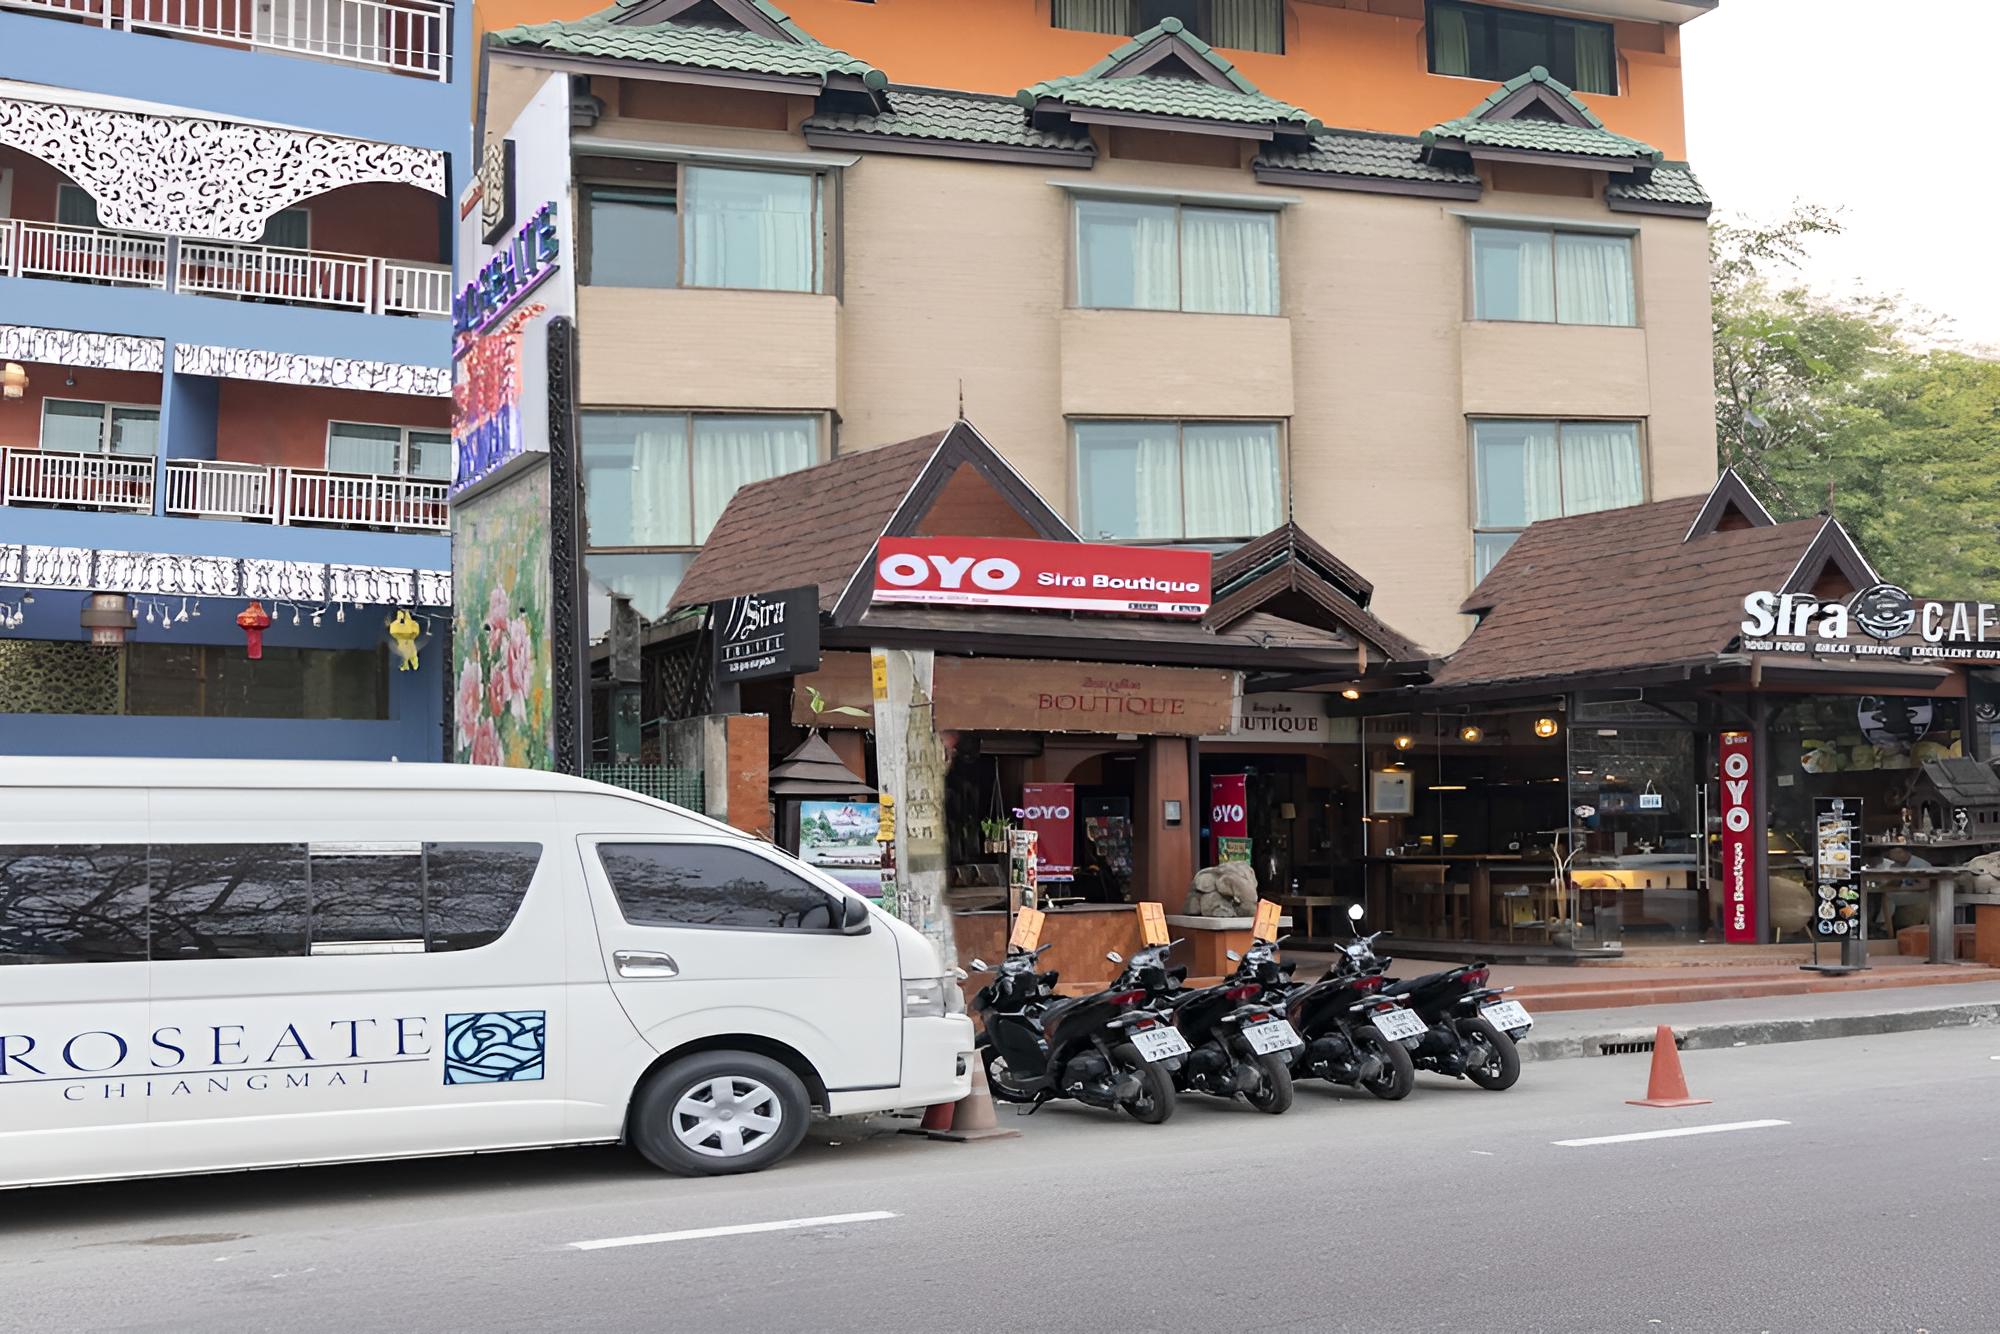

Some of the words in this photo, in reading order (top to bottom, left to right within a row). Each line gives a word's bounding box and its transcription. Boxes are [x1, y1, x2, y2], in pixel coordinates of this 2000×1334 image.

[879, 553, 1021, 591] OYO
[1037, 571, 1087, 588] Sira
[1091, 573, 1200, 594] Boutique
[739, 599, 787, 640] Sira
[1740, 590, 1849, 639] Sira
[1037, 693, 1186, 716] BOUTIQUE
[1240, 716, 1319, 734] UTIQUE
[1724, 752, 1750, 833] OYO
[1025, 805, 1070, 820] OYO
[1213, 804, 1244, 823] OYO
[0, 1015, 432, 1078] ROSEATE
[63, 1068, 370, 1101] CHIANGMAI
